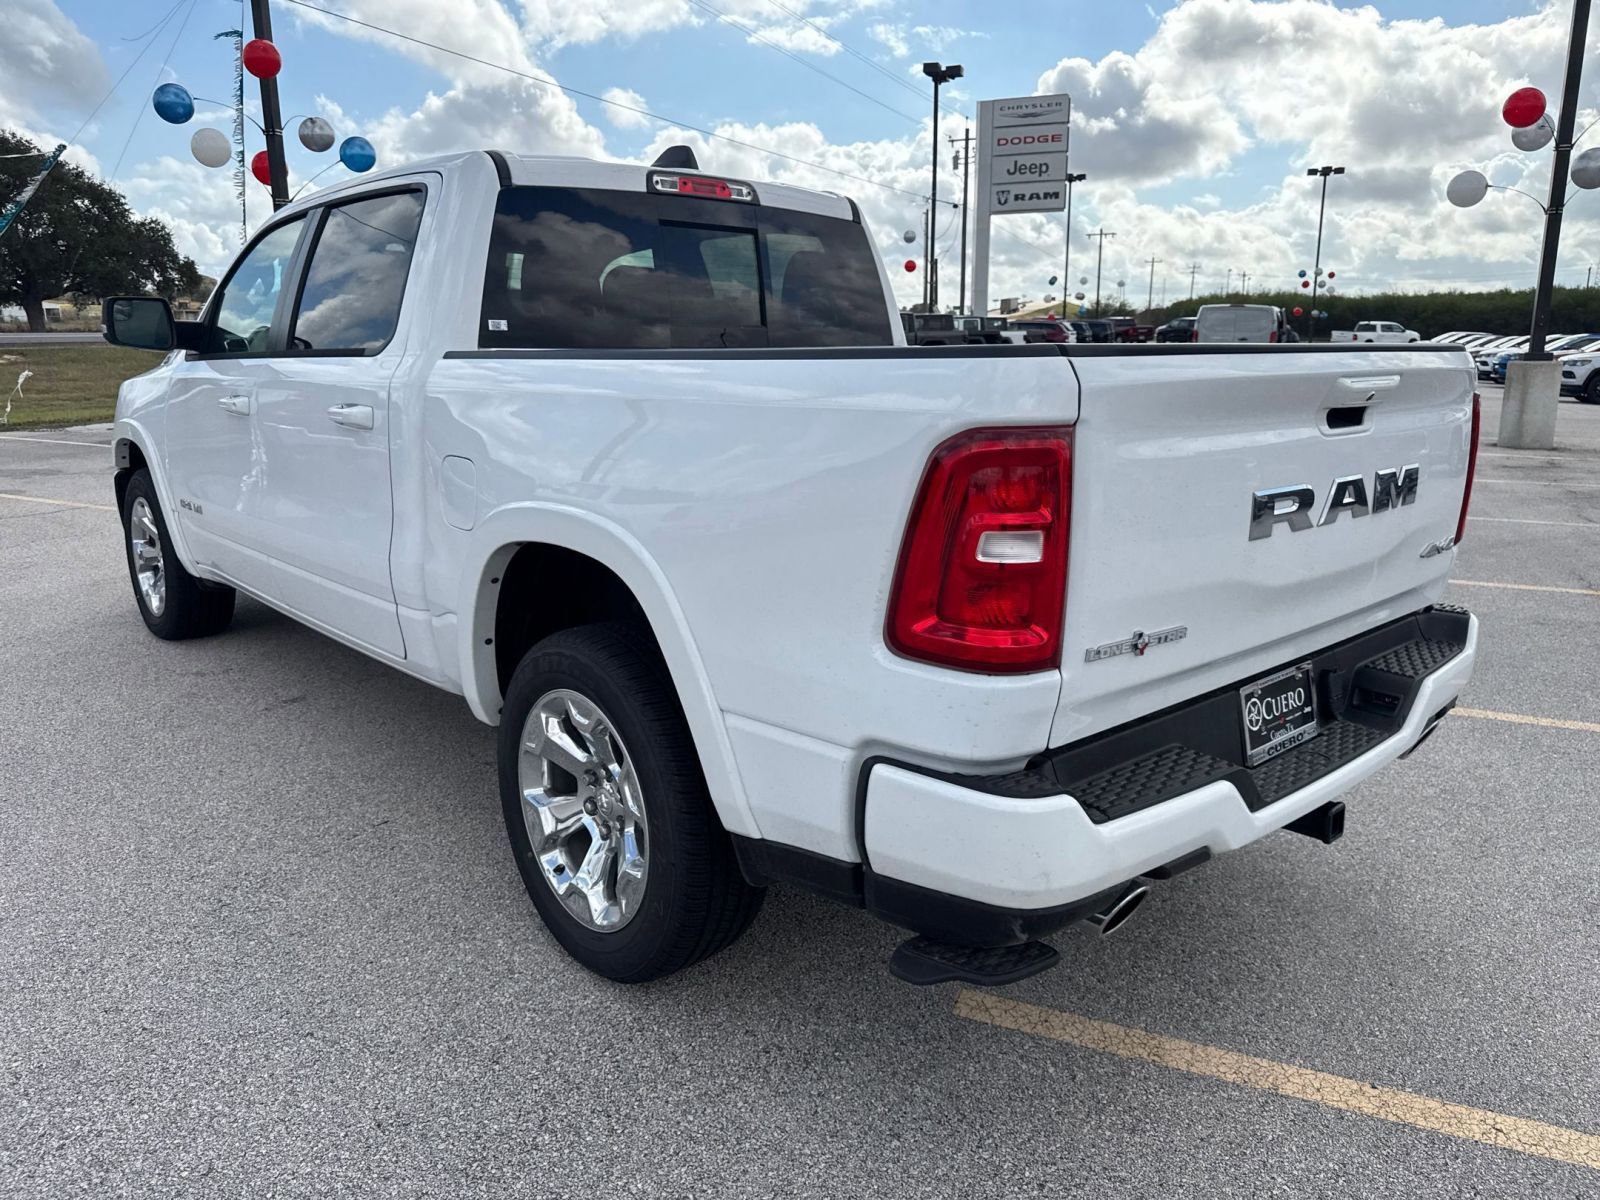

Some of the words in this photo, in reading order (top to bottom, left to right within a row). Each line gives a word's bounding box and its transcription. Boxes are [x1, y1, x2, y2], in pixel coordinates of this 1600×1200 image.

[999, 101, 1063, 112] CHRYSLER
[996, 133, 1063, 147] DODGE
[1006, 160, 1050, 177] Jeep
[1013, 191, 1060, 202] RAM
[1248, 463, 1420, 542] RAM
[1084, 638, 1133, 663] LONE
[1147, 626, 1188, 648] STAR
[1262, 687, 1305, 720] CUERO
[1266, 732, 1304, 757] CUERO
